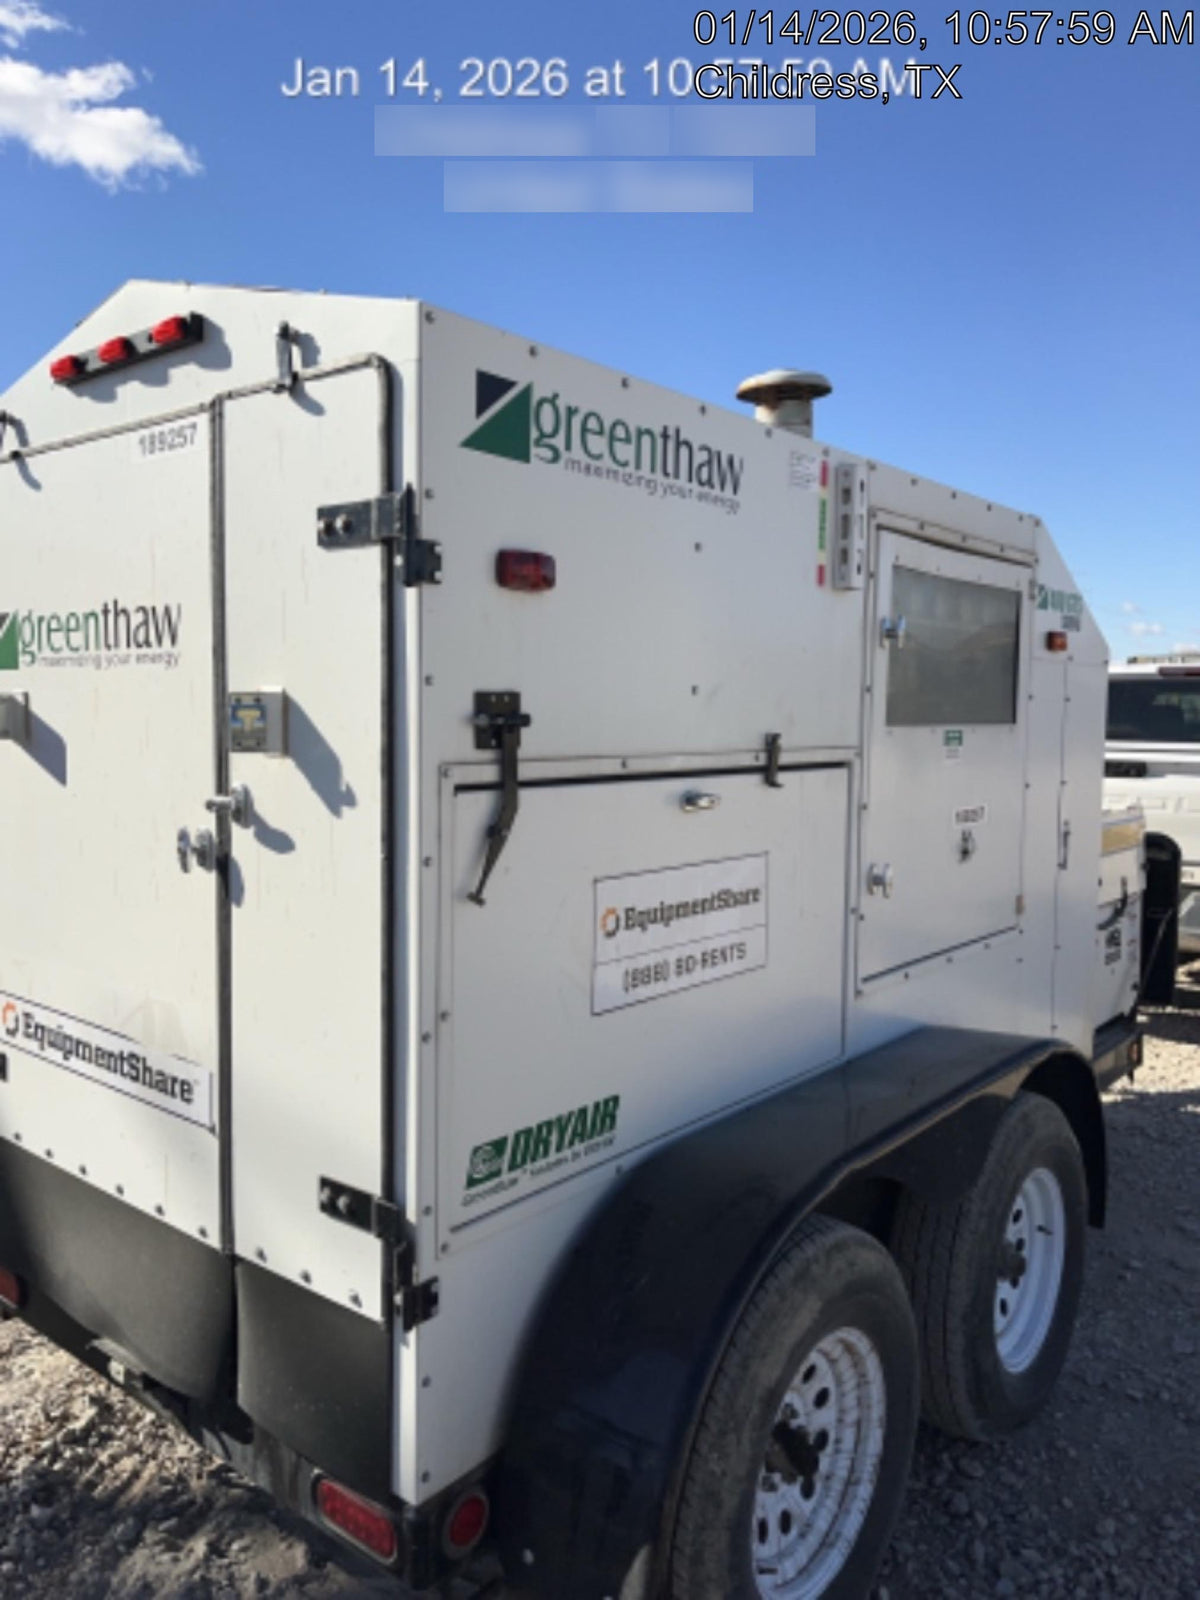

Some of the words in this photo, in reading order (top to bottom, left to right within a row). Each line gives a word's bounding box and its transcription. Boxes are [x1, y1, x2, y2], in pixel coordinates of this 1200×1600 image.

[532, 391, 744, 496] greenthaw
[20, 598, 181, 666] greenthaw
[623, 887, 760, 933] EquipmentShare
[21, 1010, 194, 1105] EquipmentShare
[507, 1093, 621, 1173] DRYAIR
